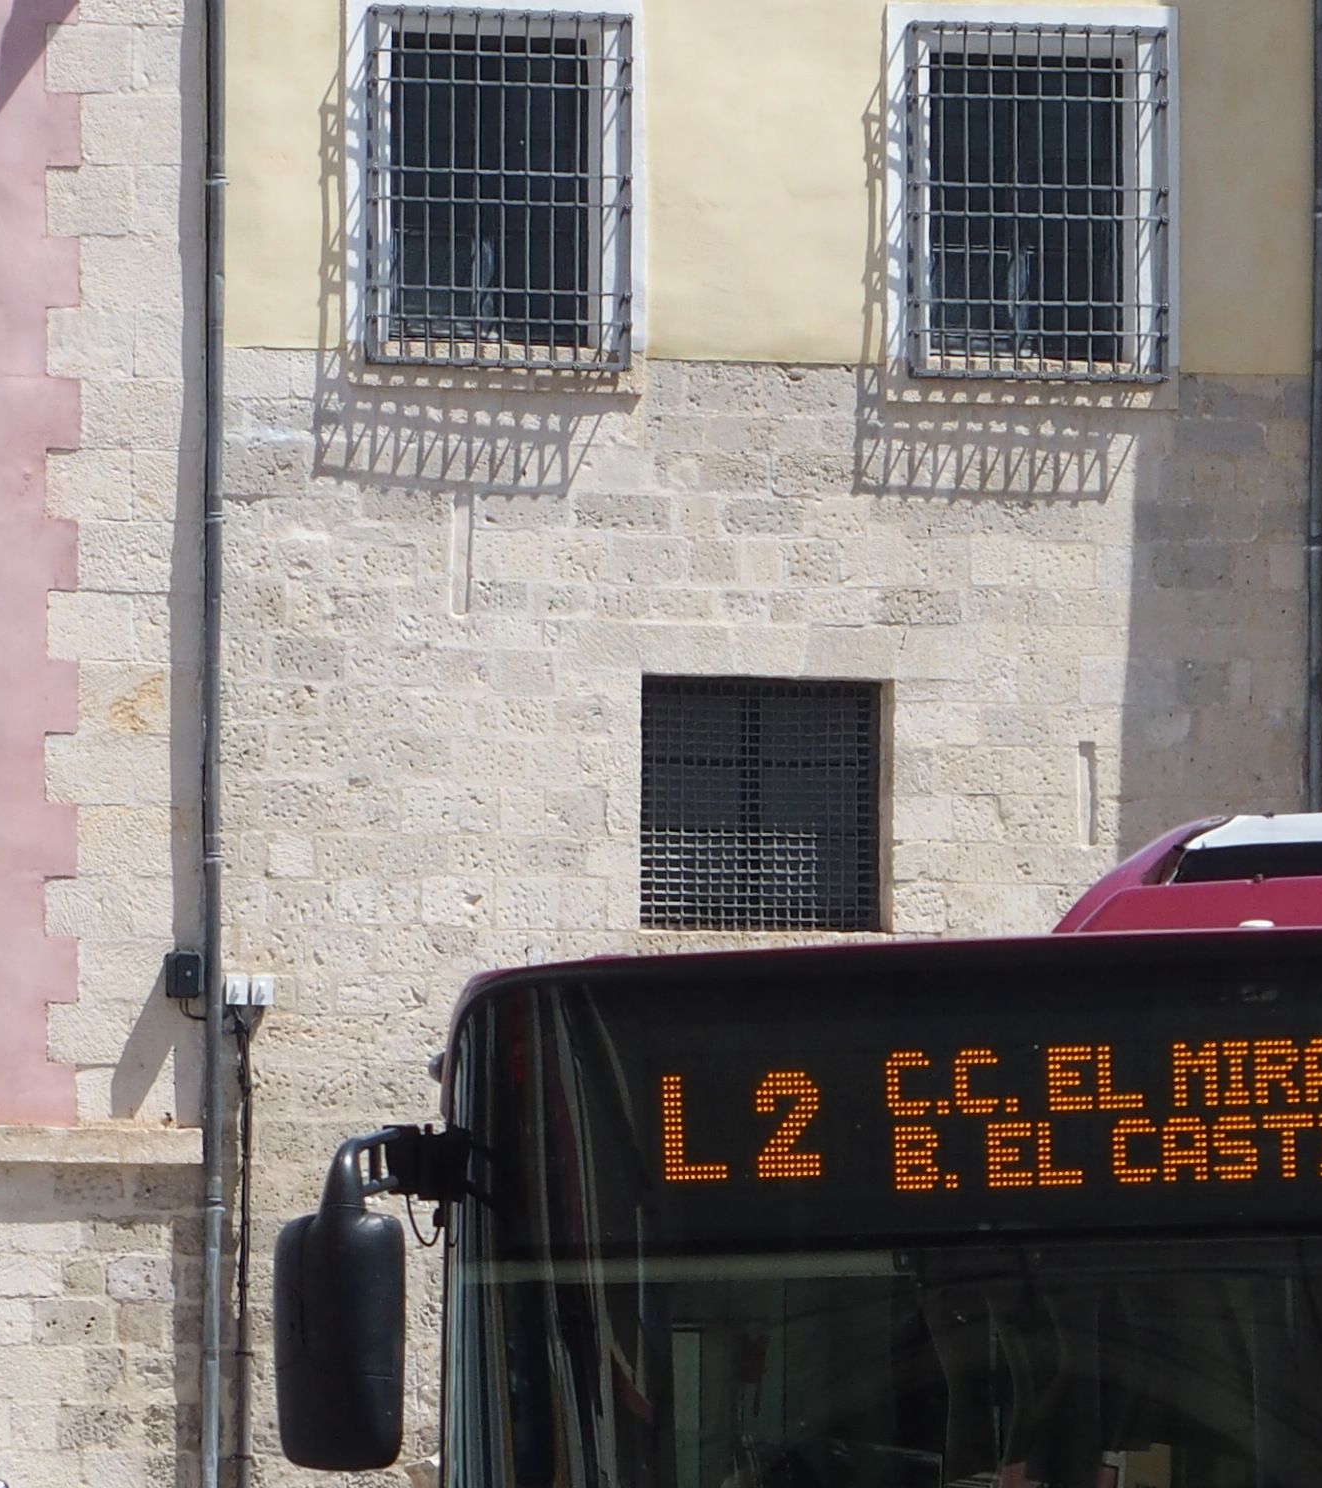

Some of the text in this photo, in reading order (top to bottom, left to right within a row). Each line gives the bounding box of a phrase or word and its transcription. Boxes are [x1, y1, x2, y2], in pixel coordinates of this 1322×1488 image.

[885, 1048, 1020, 1118] C.C.
[1047, 1045, 1144, 1112] EL
[662, 1070, 821, 1181] L 2
[894, 1125, 959, 1191] B.
[986, 1119, 1083, 1188] EL
